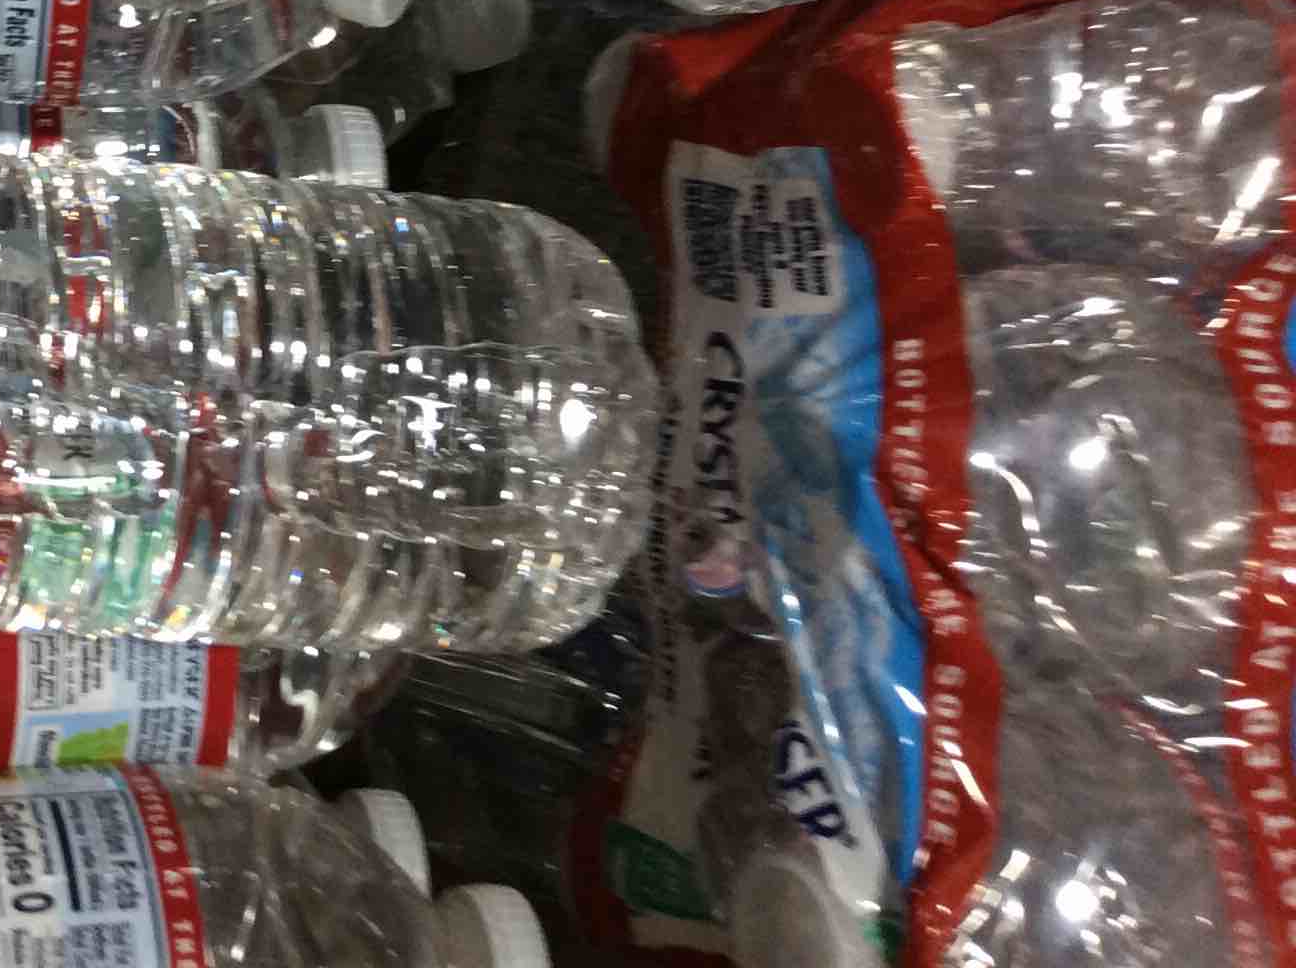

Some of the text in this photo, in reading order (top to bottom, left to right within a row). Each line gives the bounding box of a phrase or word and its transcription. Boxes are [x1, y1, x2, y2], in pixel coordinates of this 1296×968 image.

[3, 6, 36, 49] Facts
[54, 23, 78, 49] AT
[11, 891, 54, 914] 0
